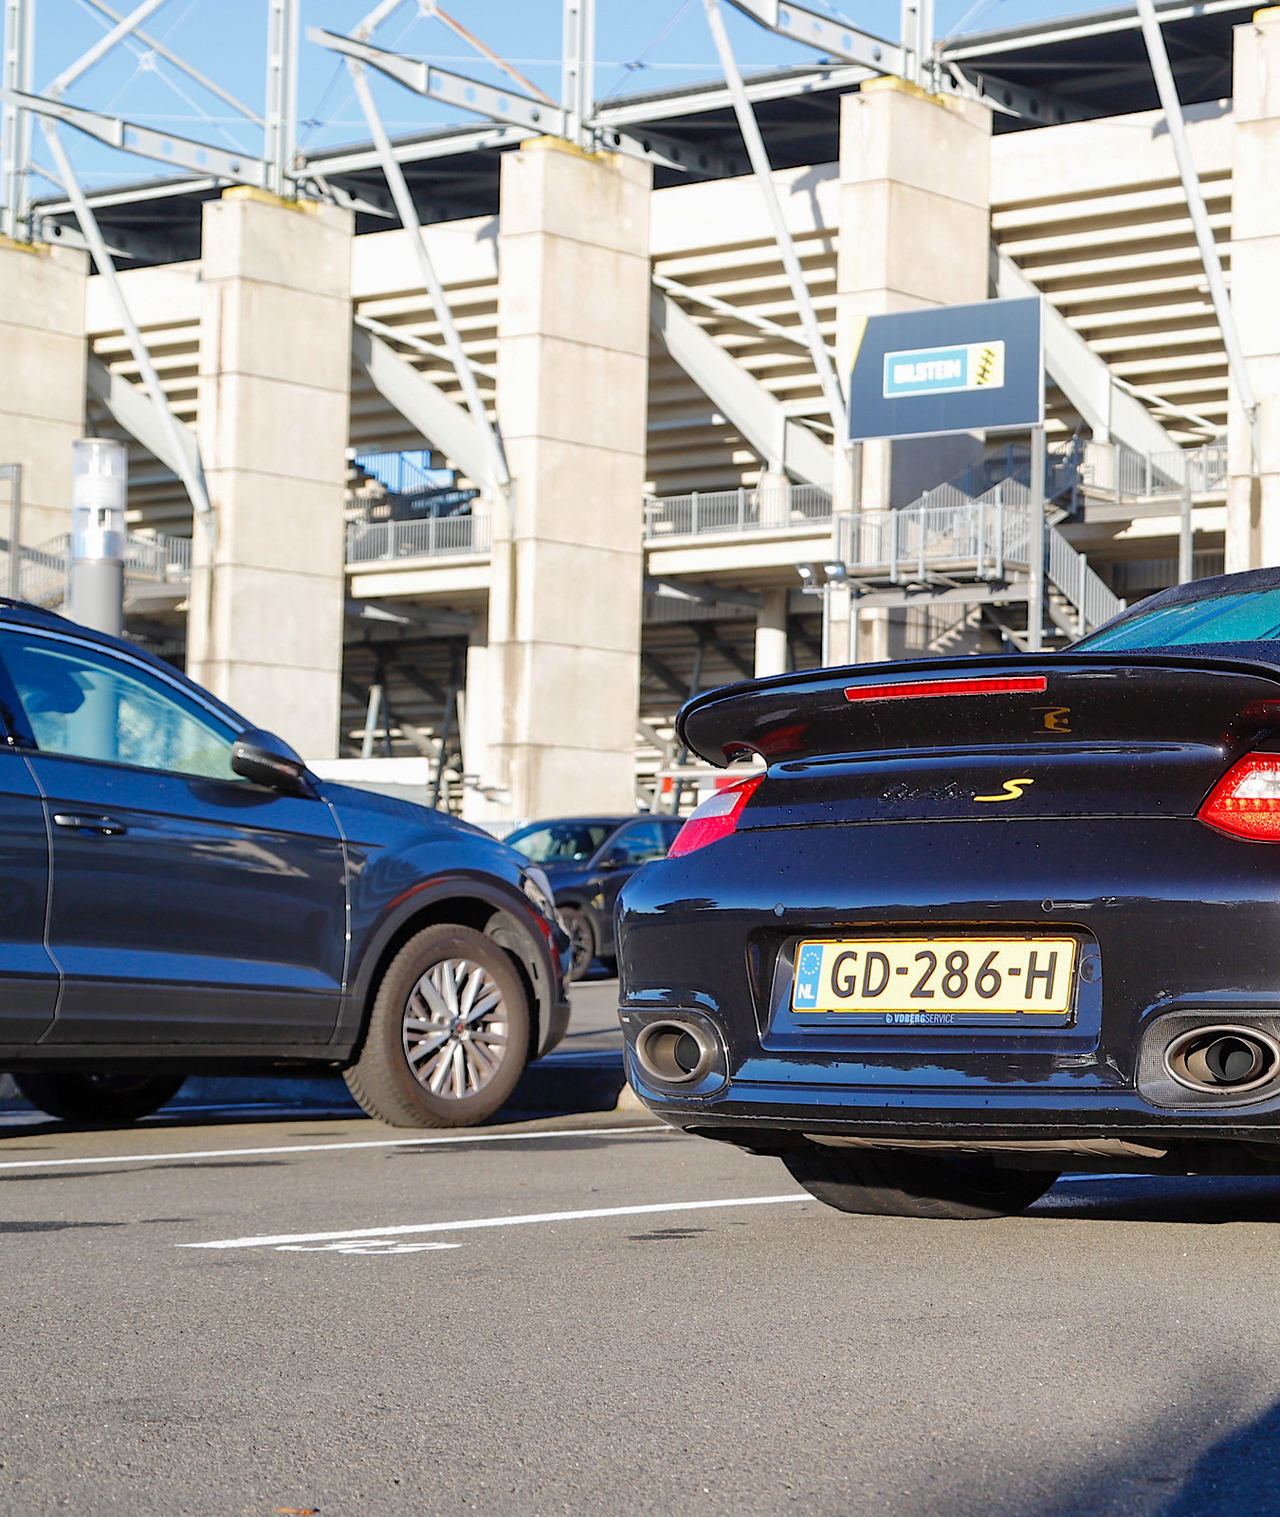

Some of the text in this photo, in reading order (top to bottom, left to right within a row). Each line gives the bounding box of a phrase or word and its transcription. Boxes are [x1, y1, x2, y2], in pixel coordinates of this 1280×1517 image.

[893, 358, 961, 384] BILSTEIN
[973, 777, 1035, 802] S
[830, 948, 1057, 1000] GD-286-H
[797, 983, 815, 999] NL
